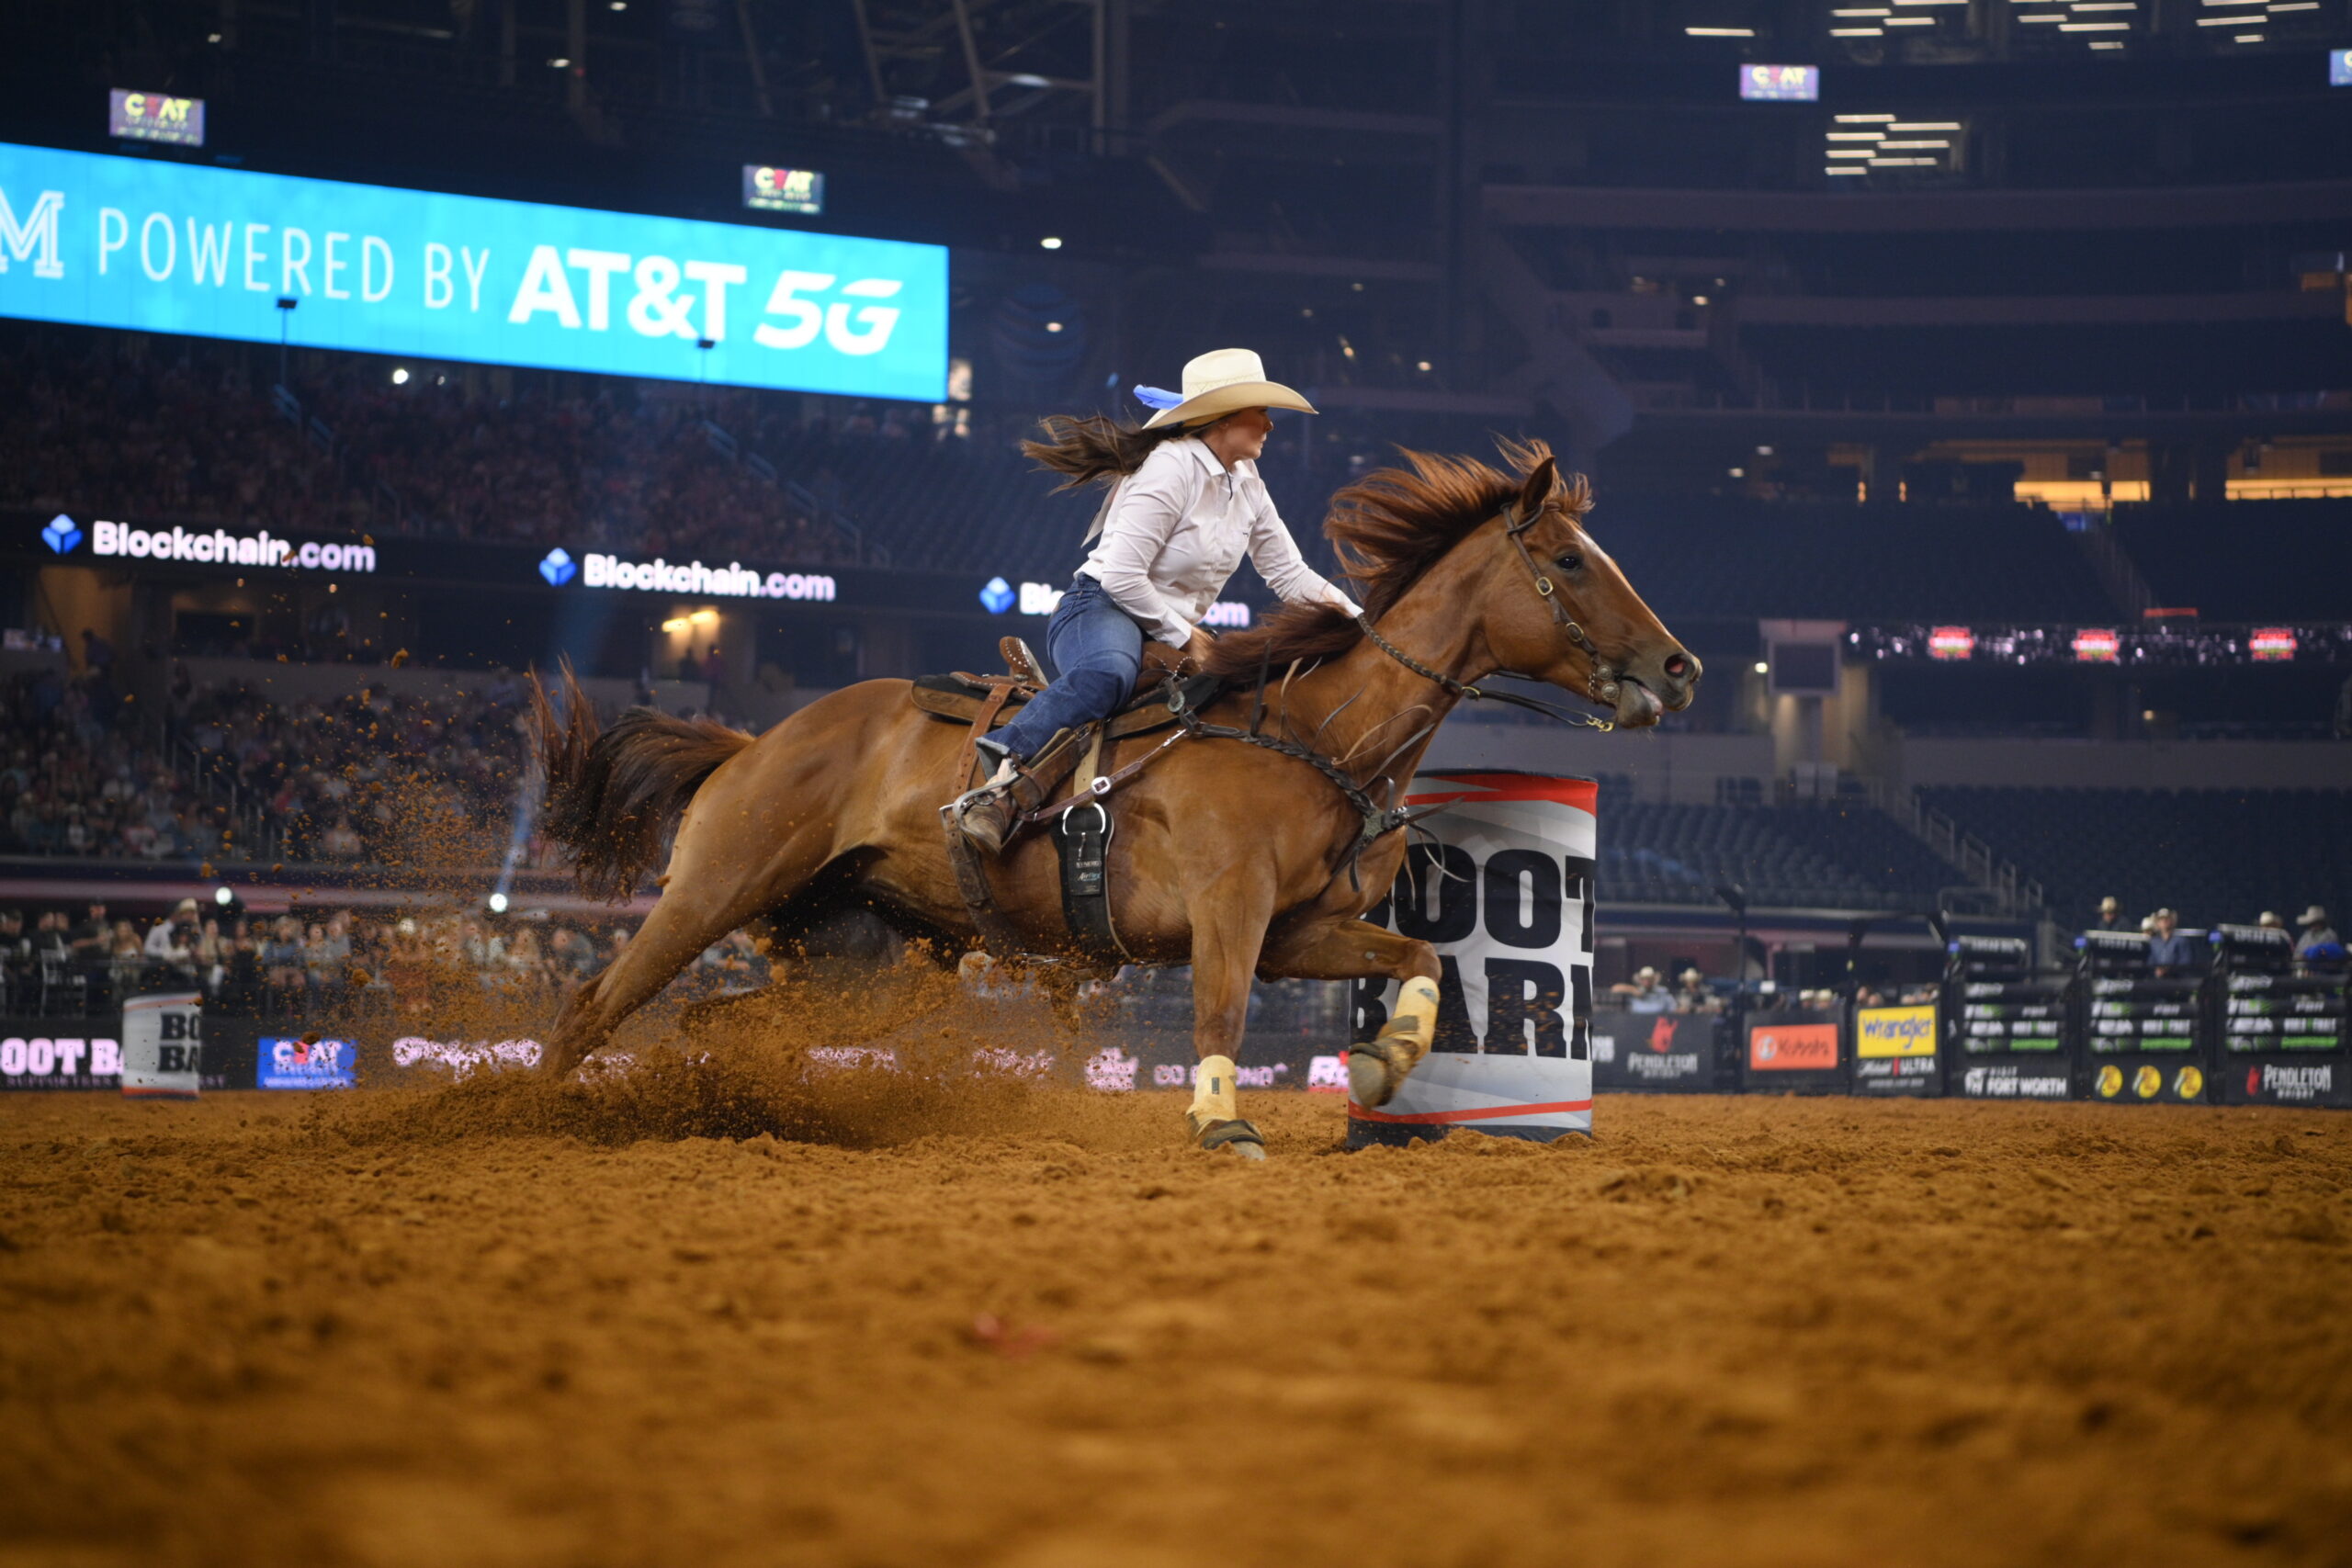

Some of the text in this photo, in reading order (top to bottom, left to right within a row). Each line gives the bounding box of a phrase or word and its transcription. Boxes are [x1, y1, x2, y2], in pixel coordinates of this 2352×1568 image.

[99, 207, 394, 302] POWERED
[424, 242, 491, 312] BY
[507, 244, 747, 342] AT&T
[753, 269, 903, 355] 5G
[93, 520, 376, 572] Blockchain.com
[583, 553, 836, 602] Blockchain.com
[1362, 843, 1596, 953] OOT
[2264, 1064, 2332, 1092] PENDLETON
